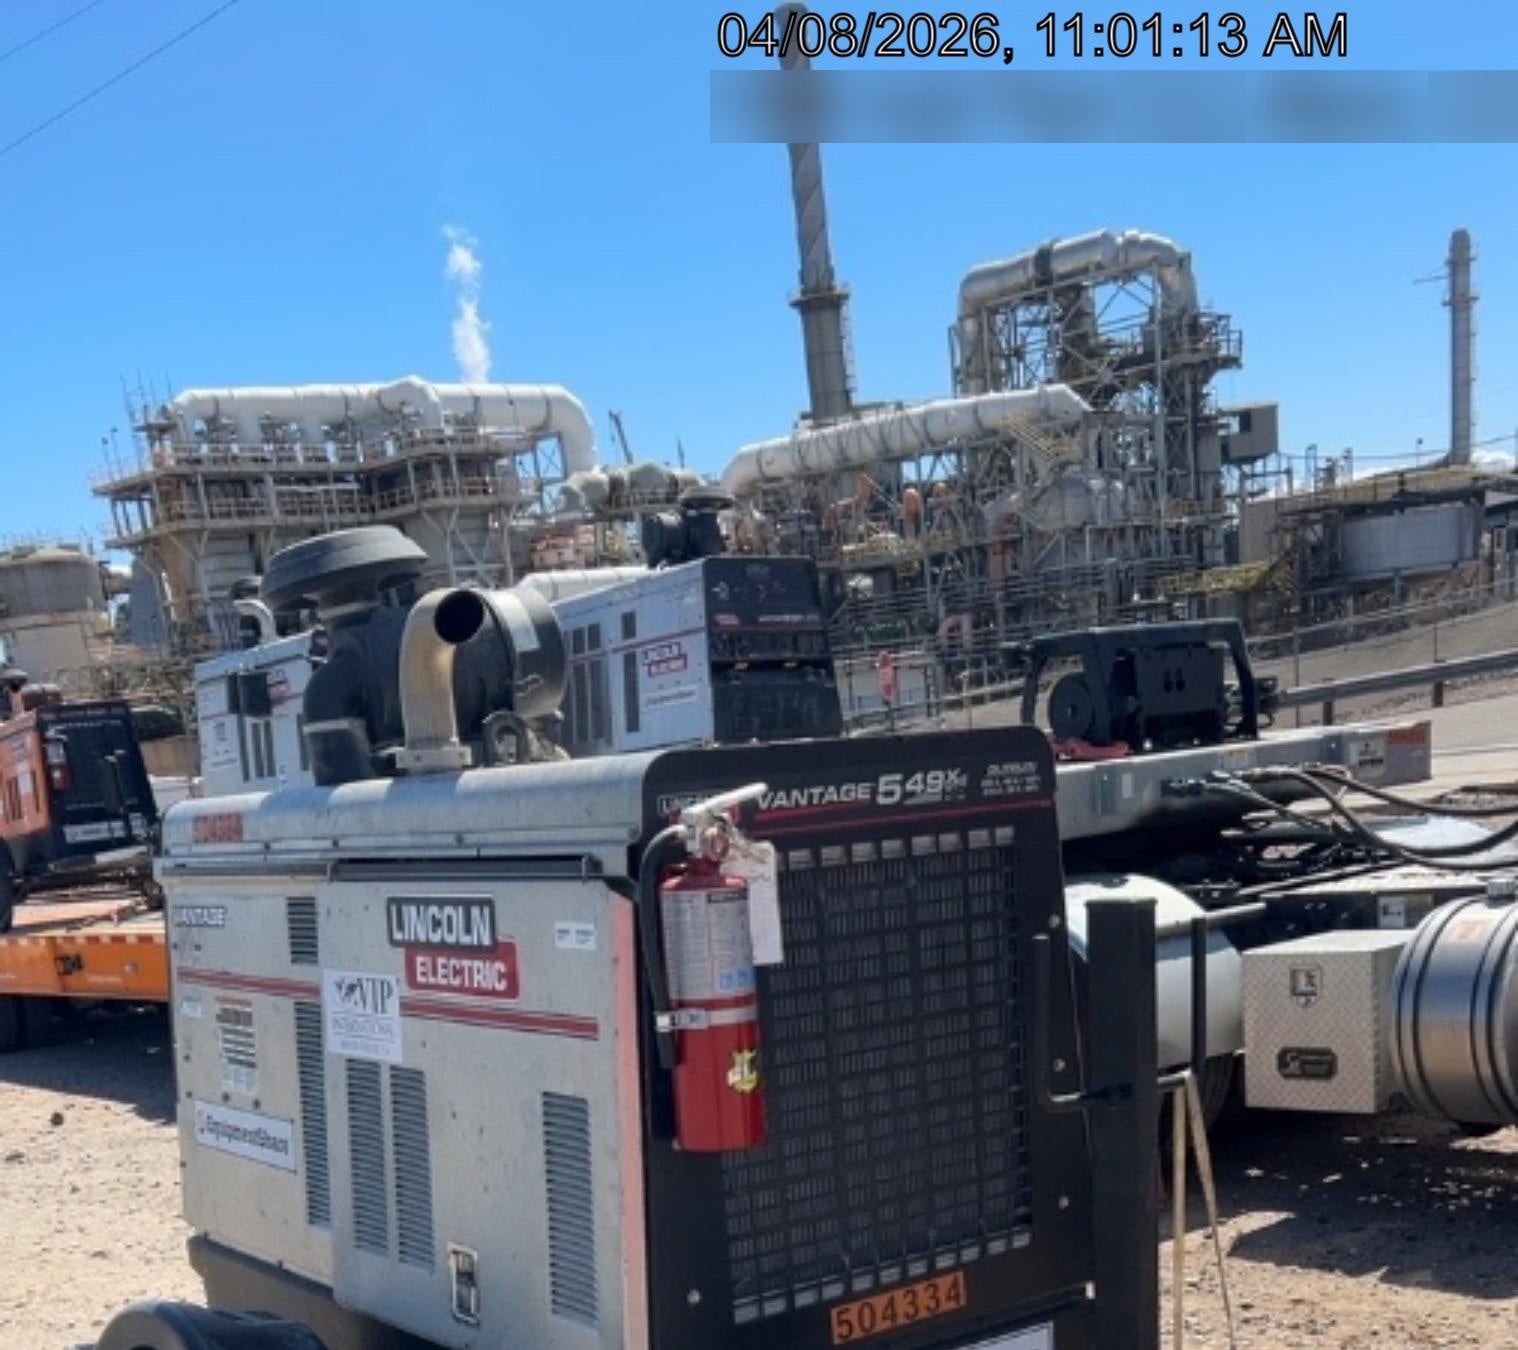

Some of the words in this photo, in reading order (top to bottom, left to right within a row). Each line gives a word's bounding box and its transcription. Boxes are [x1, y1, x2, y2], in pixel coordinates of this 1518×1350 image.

[757, 782, 874, 810] VANTAGE
[390, 903, 493, 946] LINCOLN
[415, 955, 507, 992] ELECTRIC
[836, 1275, 962, 1340] 504334
